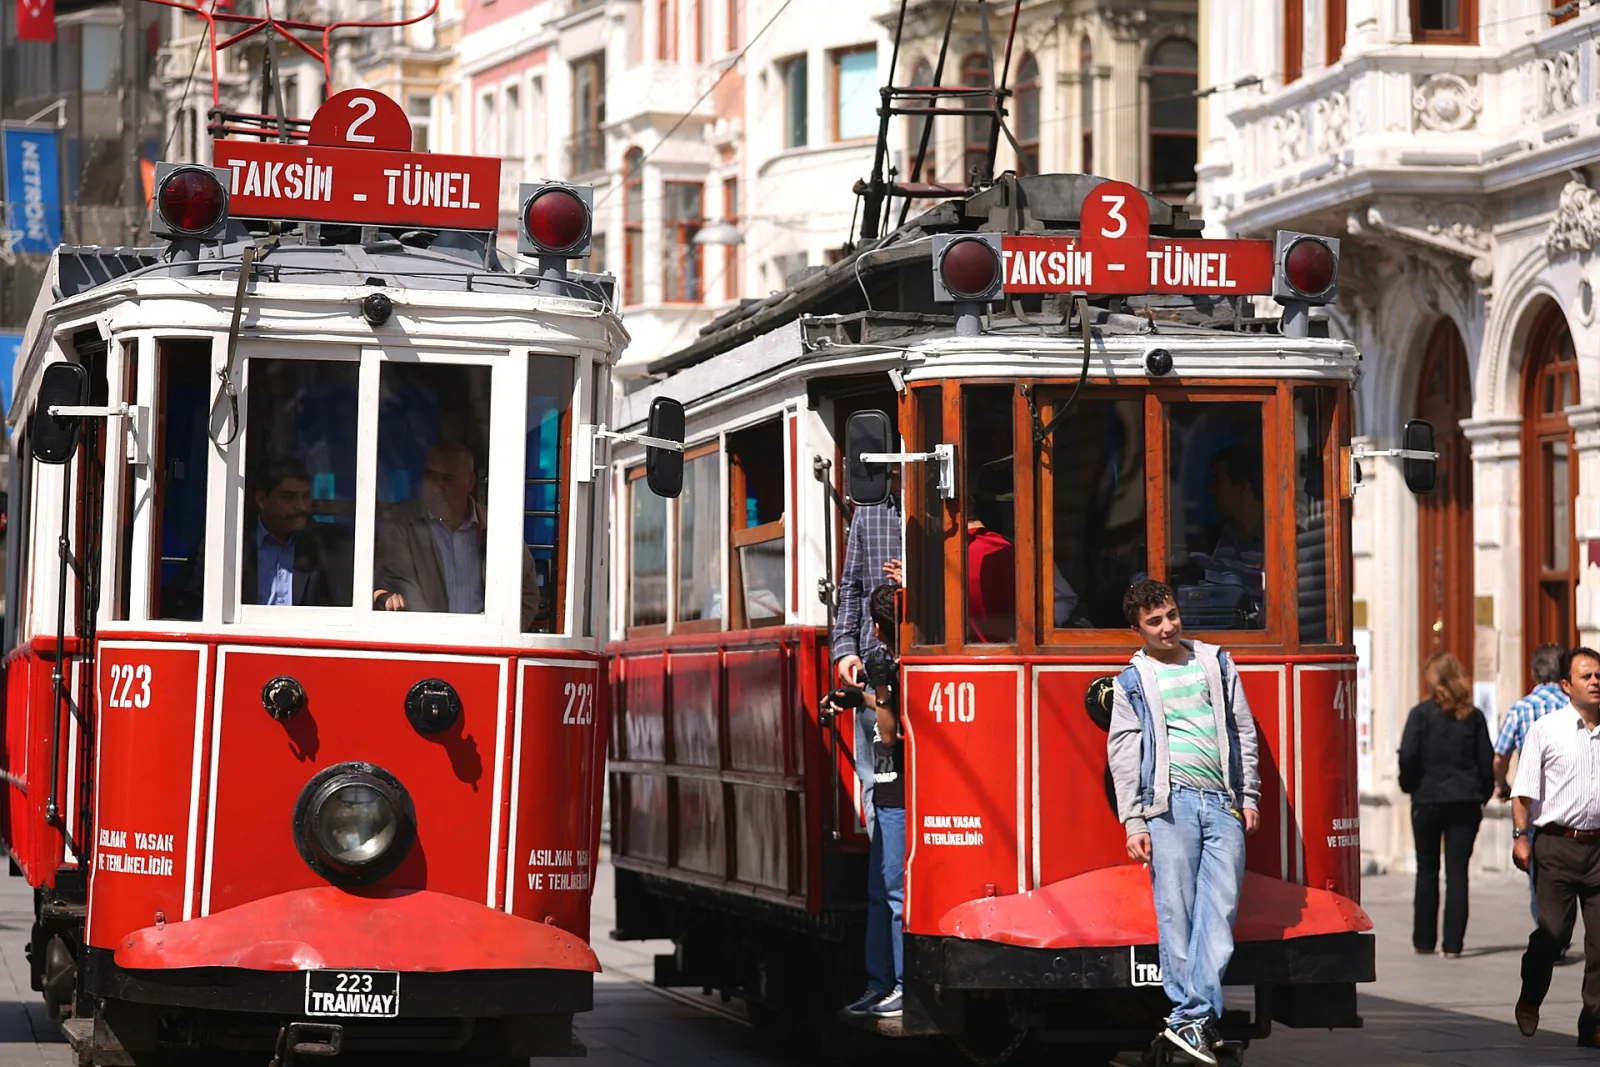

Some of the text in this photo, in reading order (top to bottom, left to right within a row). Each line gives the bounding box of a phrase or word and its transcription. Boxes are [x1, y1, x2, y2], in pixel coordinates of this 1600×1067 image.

[346, 97, 377, 143] 2
[228, 158, 333, 202] TAKSİM
[383, 163, 480, 209] TÜNEL
[1101, 195, 1128, 239] 3
[1002, 244, 1092, 286] TAKSİM
[1146, 245, 1237, 288] TÜNEL
[109, 664, 152, 709] 223
[563, 682, 593, 725] 223
[929, 682, 975, 723] 410
[952, 816, 982, 828] YASAK
[134, 832, 174, 852] YASAK
[1327, 835, 1338, 848] VE
[528, 849, 573, 866] ASILMAK
[528, 873, 543, 890] VE
[335, 973, 373, 992] 223
[312, 992, 394, 1014] TRAMVAY
